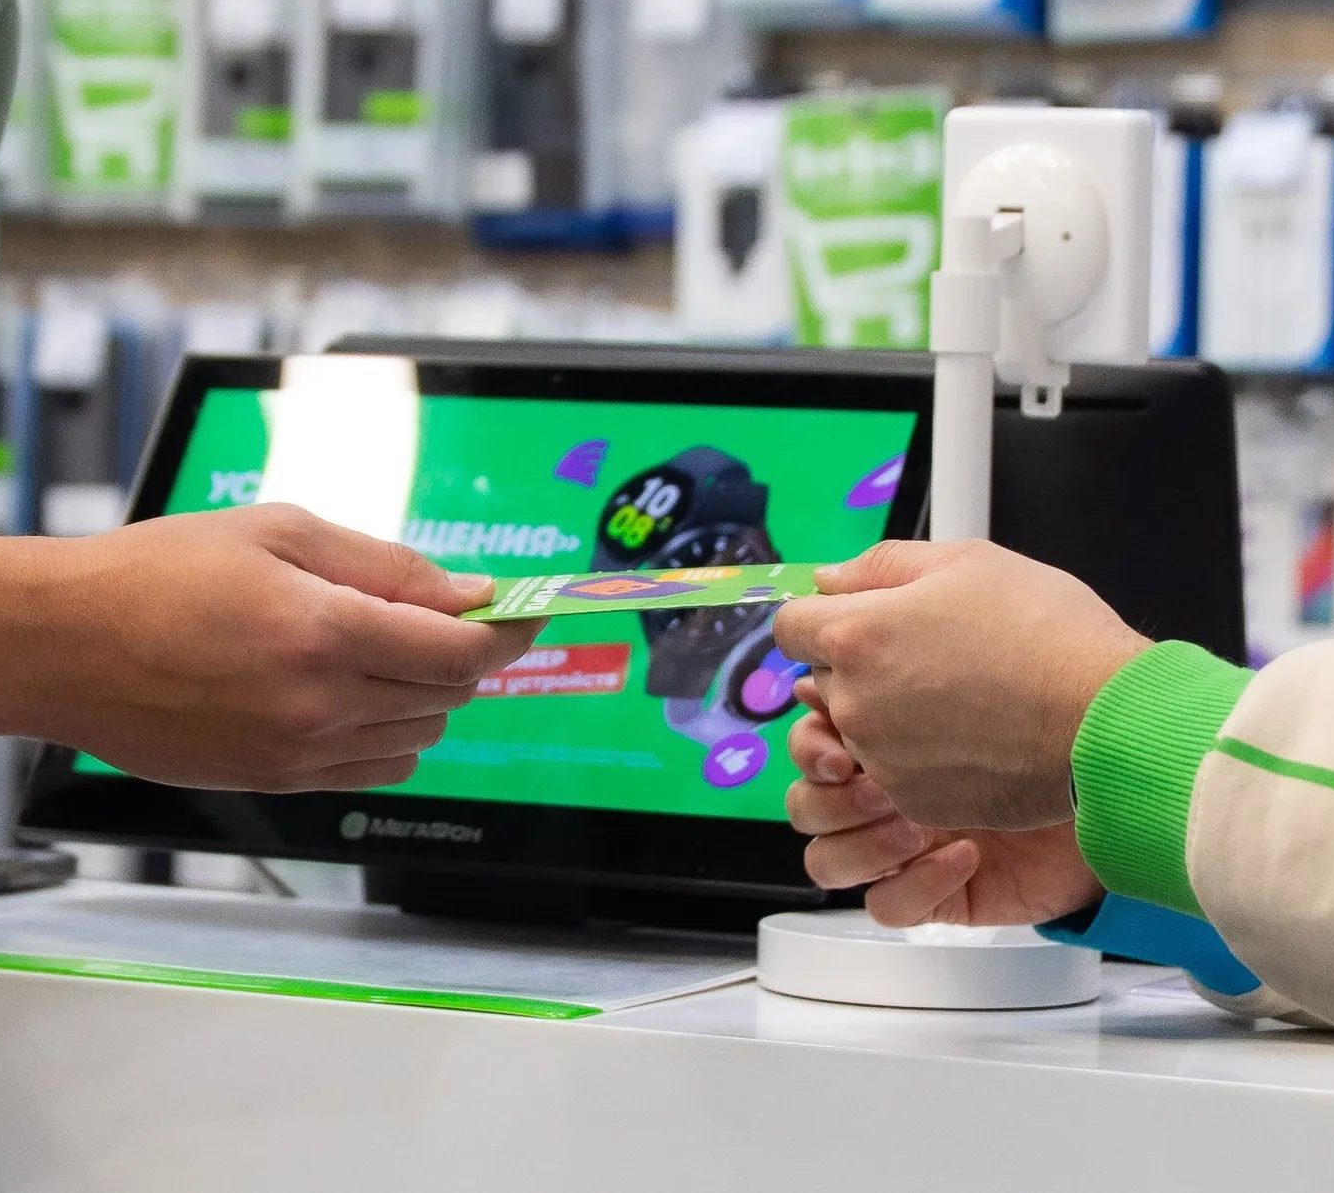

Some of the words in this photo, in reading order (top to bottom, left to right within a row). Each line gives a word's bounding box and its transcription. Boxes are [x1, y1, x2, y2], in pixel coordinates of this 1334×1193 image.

[633, 476, 681, 519] 10
[404, 518, 580, 558] ЩЕНИЯ»
[607, 504, 655, 549] 08
